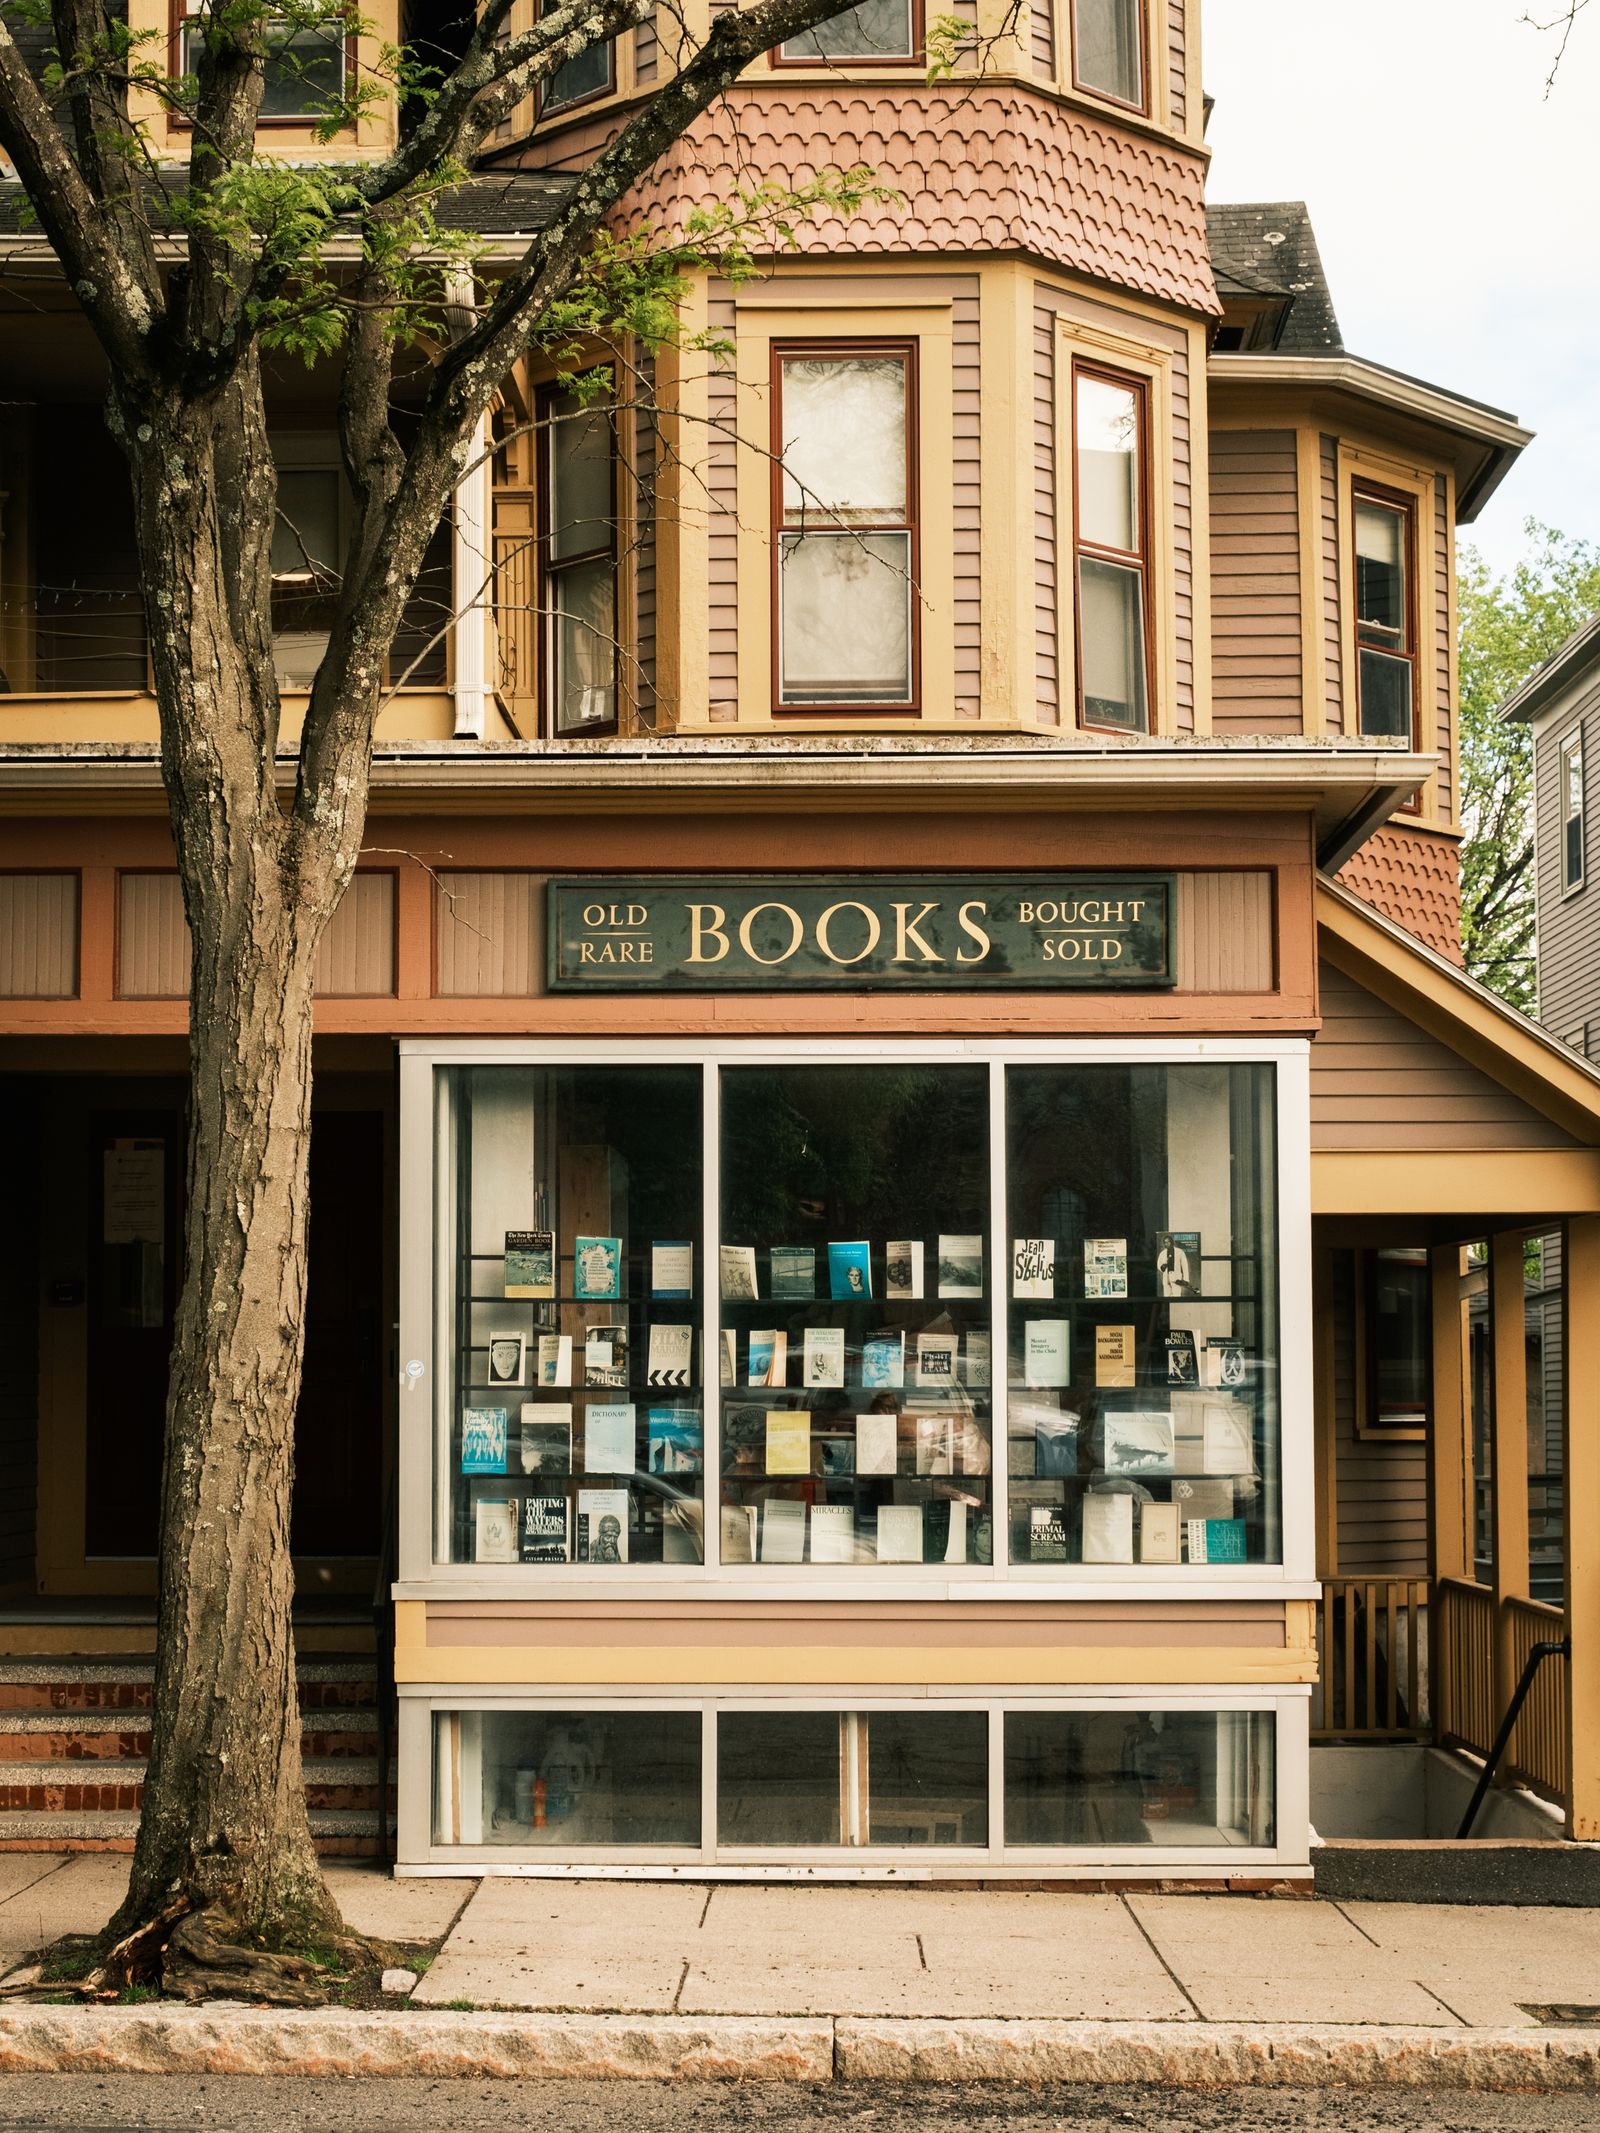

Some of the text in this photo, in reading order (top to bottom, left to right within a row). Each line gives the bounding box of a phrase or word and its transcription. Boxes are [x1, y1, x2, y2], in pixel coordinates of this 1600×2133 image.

[583, 904, 648, 927] OLD
[1018, 900, 1146, 926] BOUGHT
[684, 900, 991, 966] BOOKS
[579, 941, 654, 964] RARE
[1043, 938, 1123, 962] SOLD
[1021, 1239, 1045, 1256] Jean
[1015, 1253, 1055, 1281] Sibelius
[1170, 1331, 1187, 1339] PAUL
[591, 1410, 628, 1418] DICTIONARY
[525, 1498, 564, 1508] PARTING
[525, 1507, 546, 1517] THE
[811, 1506, 852, 1514] MIRACLES
[525, 1515, 564, 1525] WATERS
[1030, 1525, 1065, 1533] PRIMAL
[1030, 1533, 1066, 1542] SCREAM
